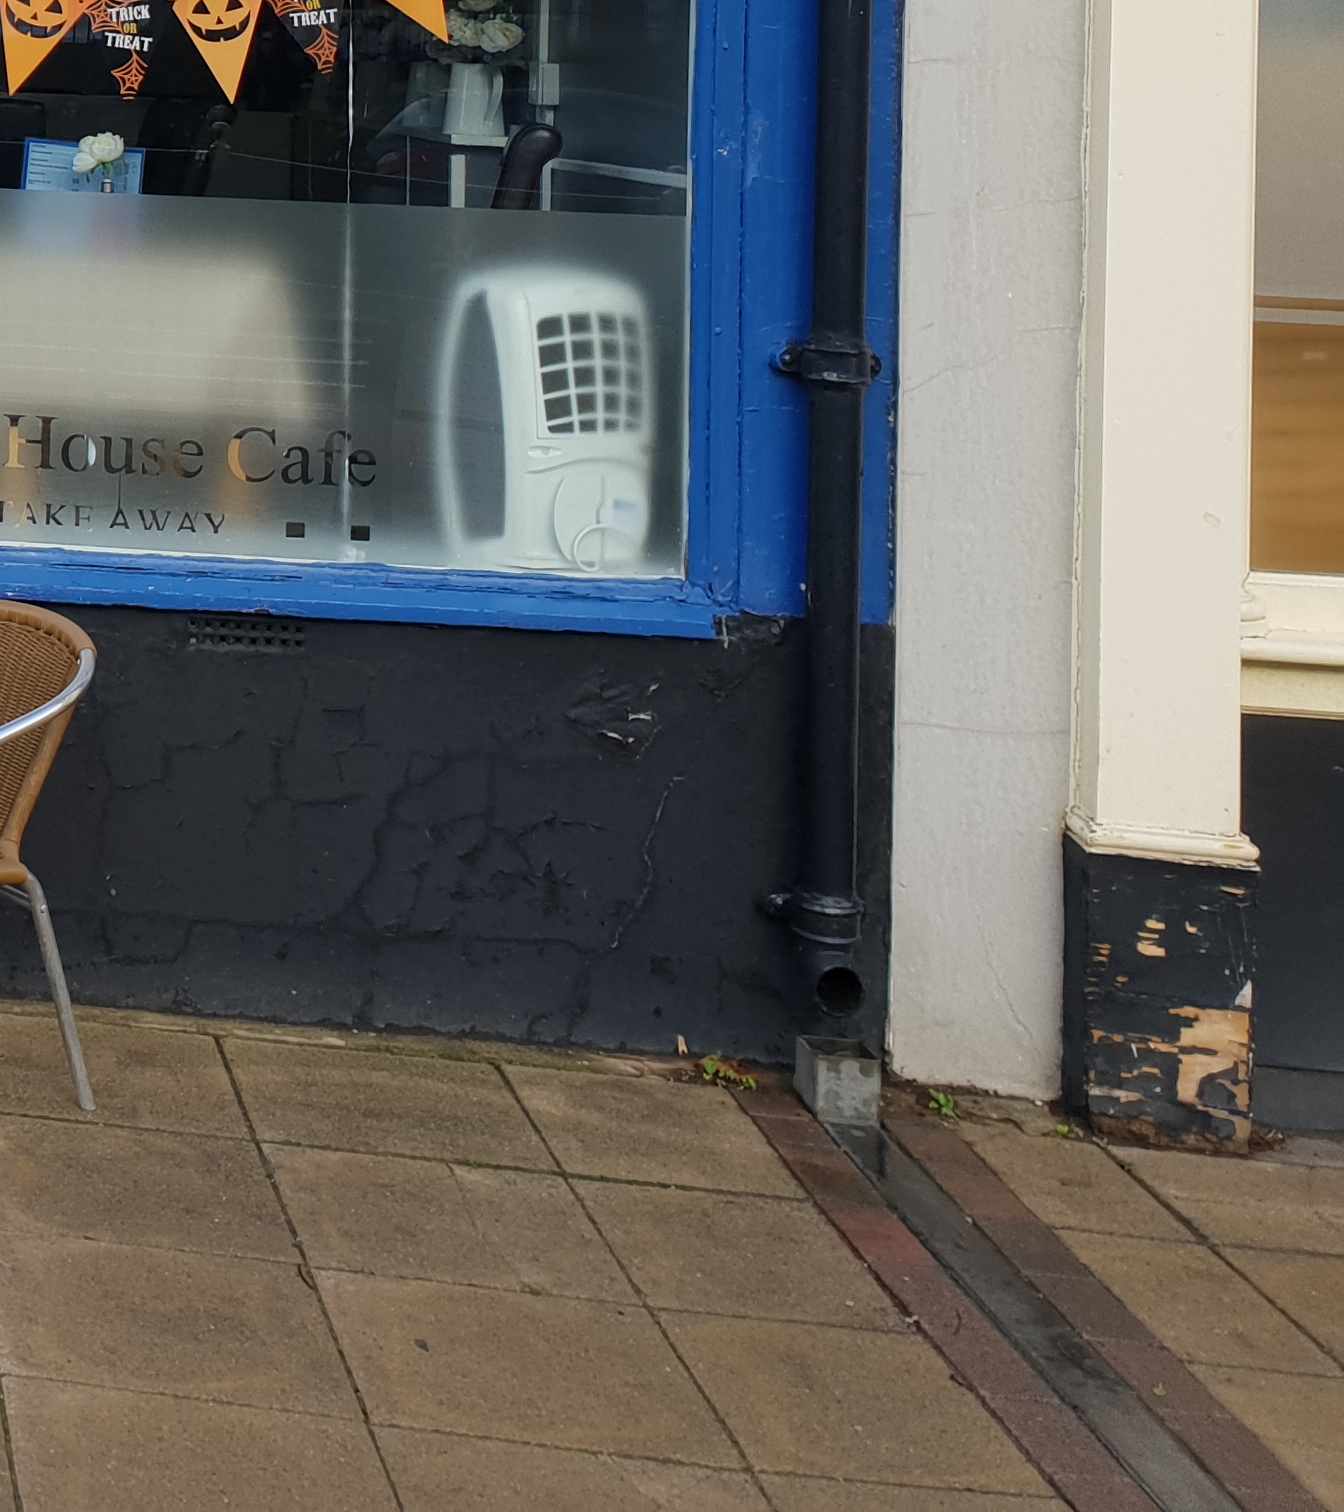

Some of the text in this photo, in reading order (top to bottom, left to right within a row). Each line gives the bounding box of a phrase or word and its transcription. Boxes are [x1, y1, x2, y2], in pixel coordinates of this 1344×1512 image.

[108, 4, 151, 23] TRICK
[289, 8, 338, 27] TREAT
[122, 21, 138, 34] OR
[103, 32, 153, 51] TREAT
[2, 413, 205, 479] House
[227, 426, 377, 488] Cafe
[108, 506, 226, 535] AWAY
